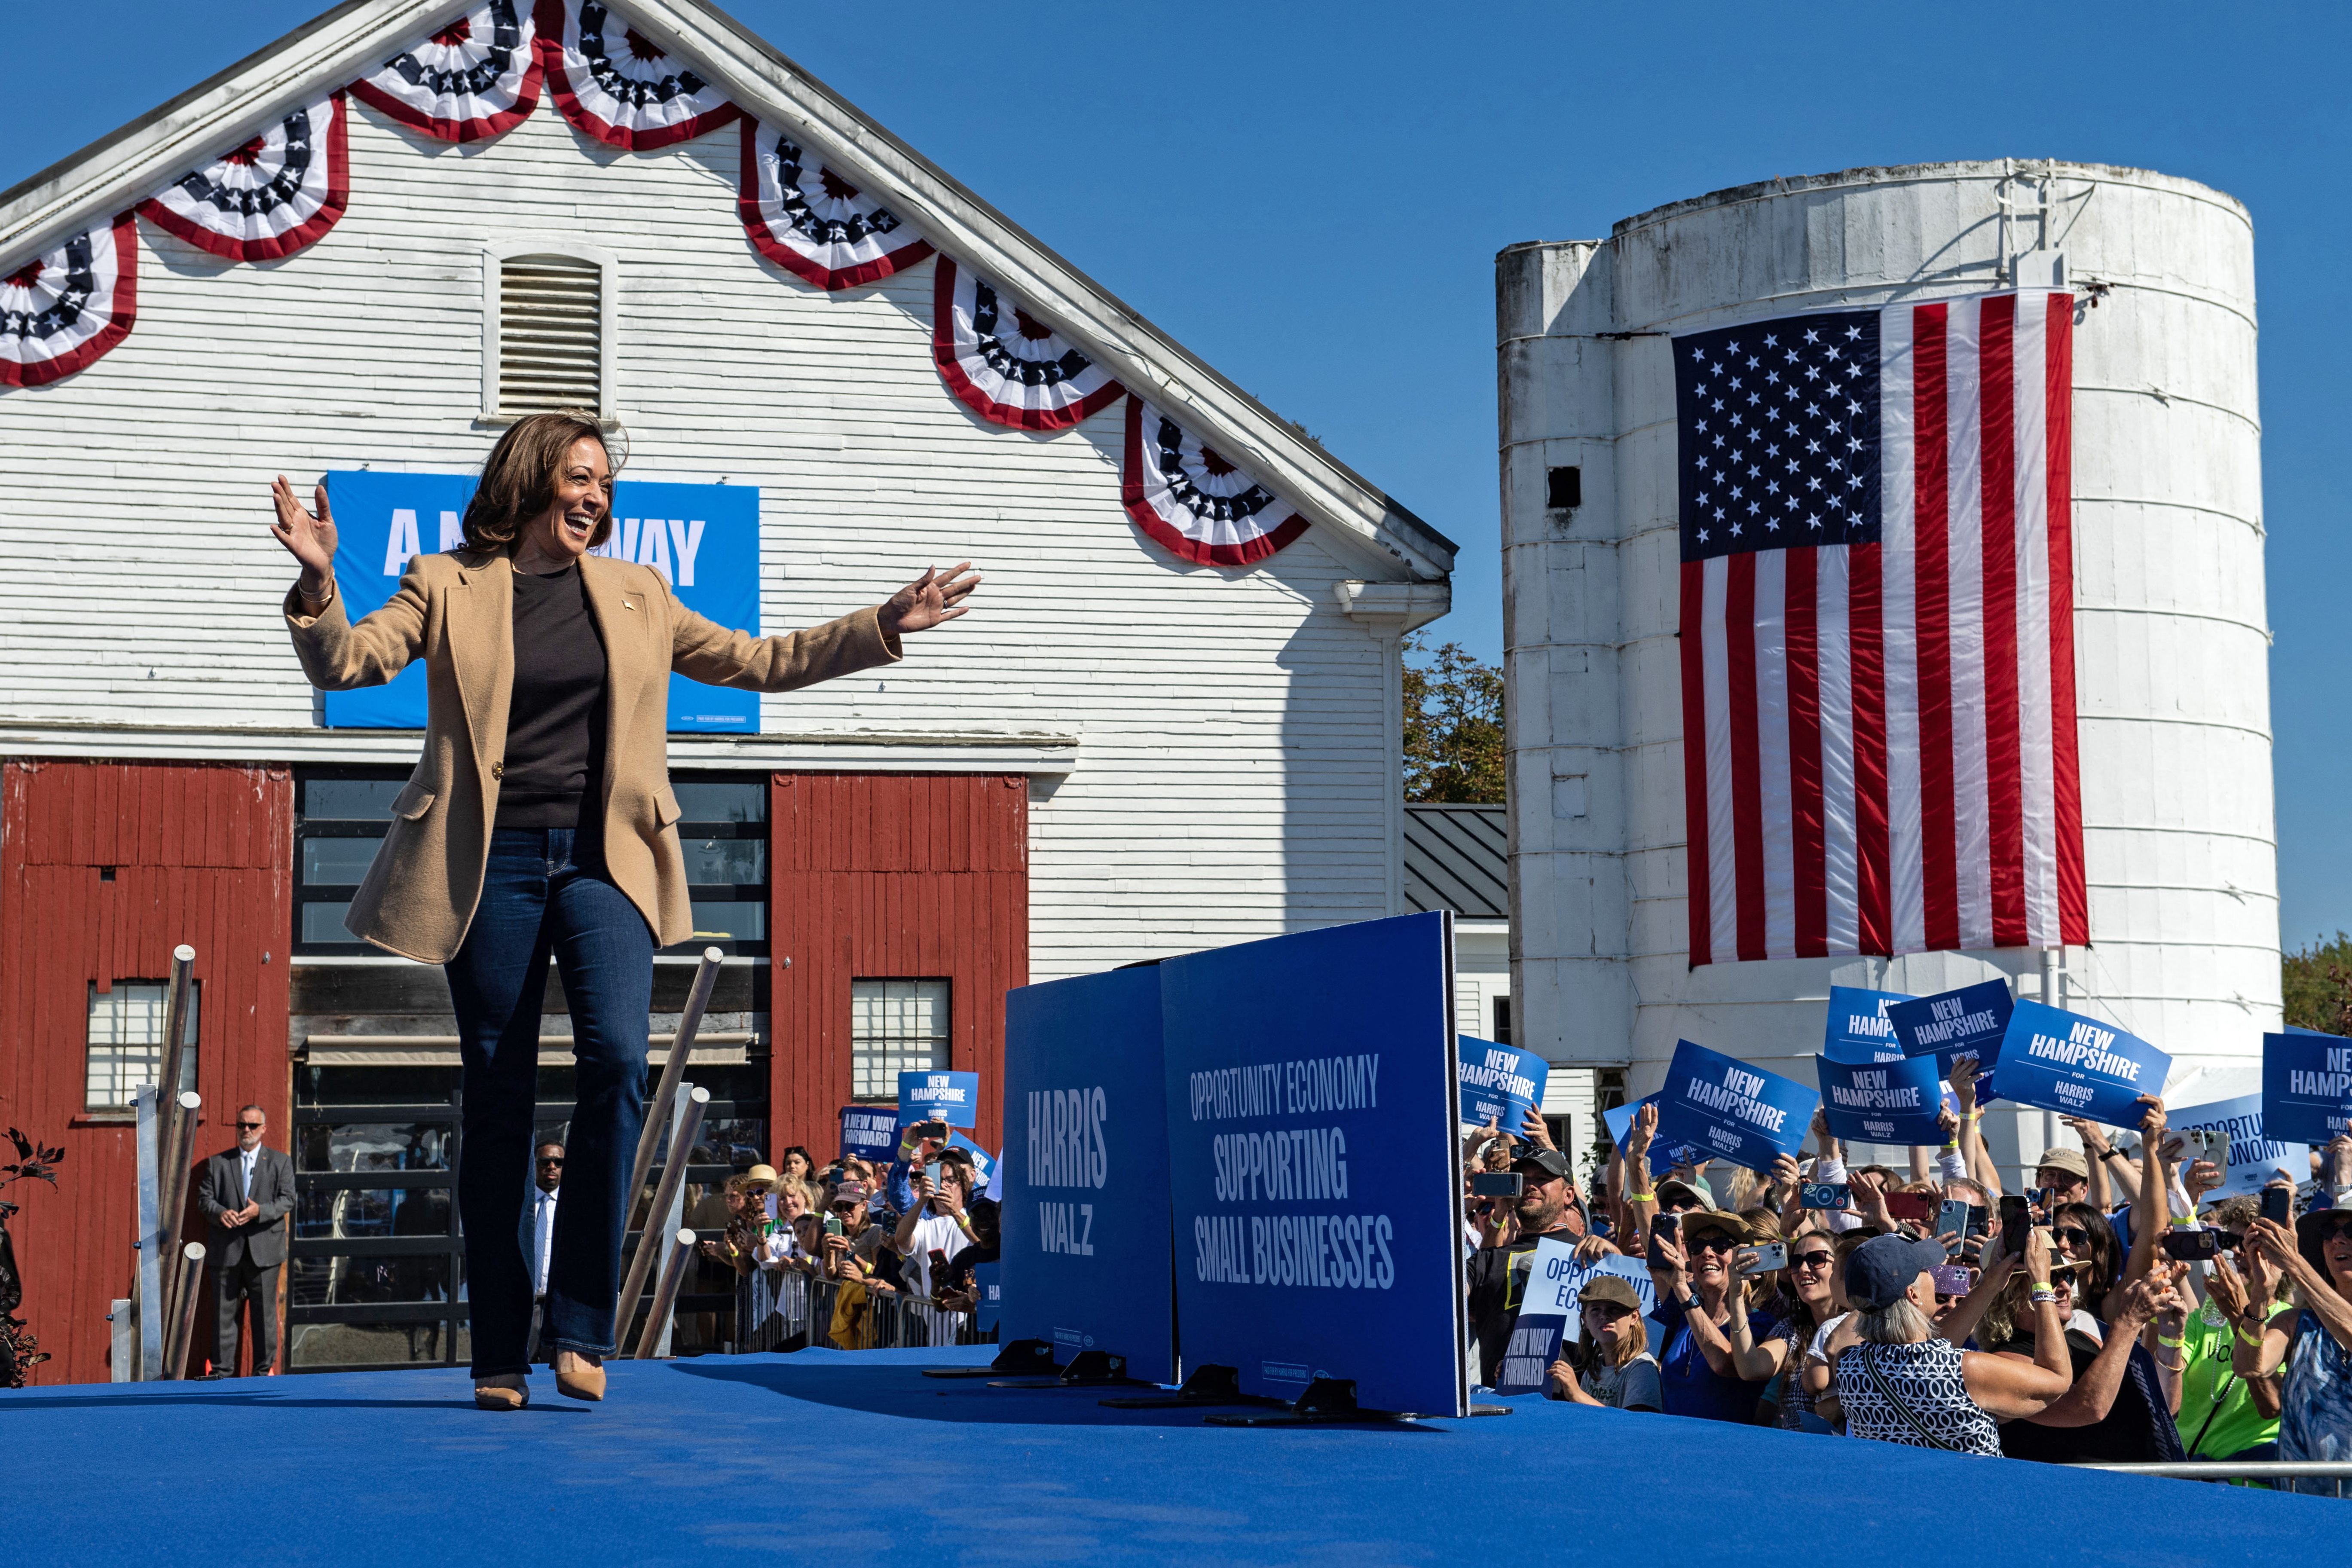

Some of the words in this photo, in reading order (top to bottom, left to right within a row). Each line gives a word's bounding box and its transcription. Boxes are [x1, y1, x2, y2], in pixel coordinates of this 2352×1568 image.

[383, 509, 421, 576] A
[1930, 997, 1964, 1021] NEW
[1849, 1015, 1897, 1039] HAMP
[1914, 1009, 1998, 1045] HAMPSHIRE
[2069, 1022, 2115, 1051] NEW
[1484, 1049, 1520, 1073] NEW
[2028, 1033, 2141, 1082] HAMPSHIRE
[2327, 1048, 2352, 1073] NE
[928, 1076, 949, 1088] NEW
[1190, 1063, 1282, 1122] OPPORTUNITY
[1288, 1054, 1379, 1114] ECONOMY
[1459, 1062, 1535, 1100] HAMPSHIRE
[1723, 1067, 1765, 1099] NEW
[1852, 1070, 1887, 1089] NEW
[2054, 1081, 2094, 1101] HARRIS
[2291, 1070, 2352, 1097] HAMP
[911, 1088, 966, 1102] HAMPSHIRE
[1687, 1077, 1786, 1133] HAMPSHIRE
[1832, 1085, 1920, 1108] HAMPSHIRE
[2059, 1096, 2085, 1108] WALZ
[1475, 1101, 1505, 1117] HARRIS
[844, 1114, 849, 1128] A
[850, 1114, 871, 1129] NEW
[872, 1116, 897, 1132] WAY
[1723, 1119, 1735, 1127] FOR
[1863, 1121, 1894, 1132] HARRIS
[845, 1129, 891, 1147] FORWARD
[1029, 1086, 1107, 1189] HARRIS
[1708, 1126, 1742, 1148] HARRIS
[1712, 1140, 1734, 1153] WALZ
[1214, 1127, 1348, 1201] SUPPORTING
[1040, 1203, 1094, 1256] WALZ
[1195, 1216, 1250, 1284] SMALL
[1252, 1214, 1394, 1290] BUSINESSES
[1511, 1328, 1529, 1356] NEW
[1529, 1328, 1555, 1356] WAY
[1504, 1358, 1545, 1386] FORWARD
